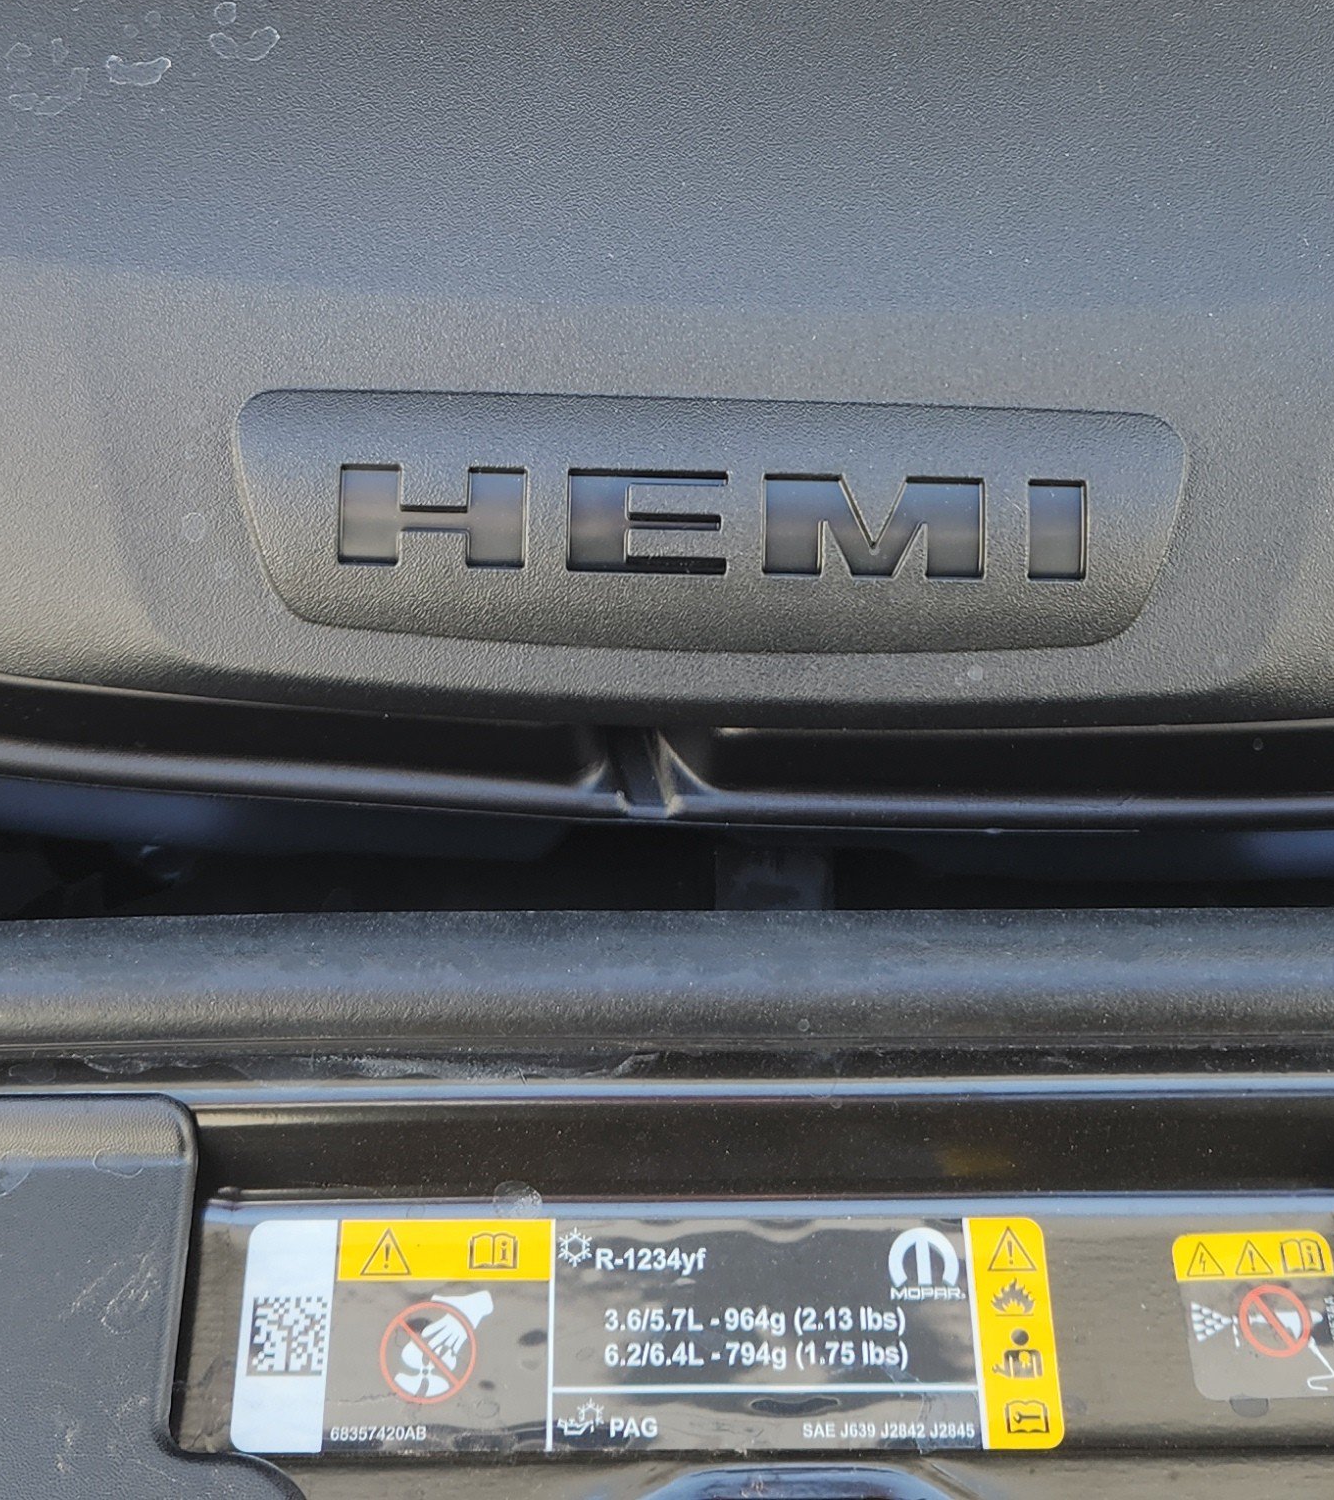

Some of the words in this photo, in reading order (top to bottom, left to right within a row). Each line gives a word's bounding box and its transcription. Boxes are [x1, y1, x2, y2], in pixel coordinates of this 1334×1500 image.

[337, 462, 1088, 581] HEMI
[595, 1248, 706, 1276] R-1234yf
[890, 1286, 962, 1300] MOPAR
[604, 1307, 703, 1332] 3.6/5.7L
[725, 1307, 786, 1335] 964g
[793, 1306, 854, 1336] (2.13
[860, 1306, 906, 1335] lbs)
[604, 1342, 704, 1367] 6.2/6.4L
[726, 1342, 787, 1370] 794g
[795, 1342, 855, 1371] (1.75
[862, 1342, 909, 1371] lbs)
[330, 1425, 428, 1442] 68357420AB
[610, 1417, 658, 1438] PAG
[802, 1422, 836, 1439] SAE
[840, 1422, 876, 1439] J639
[880, 1422, 926, 1440] J2842
[929, 1422, 975, 1439] J2845
